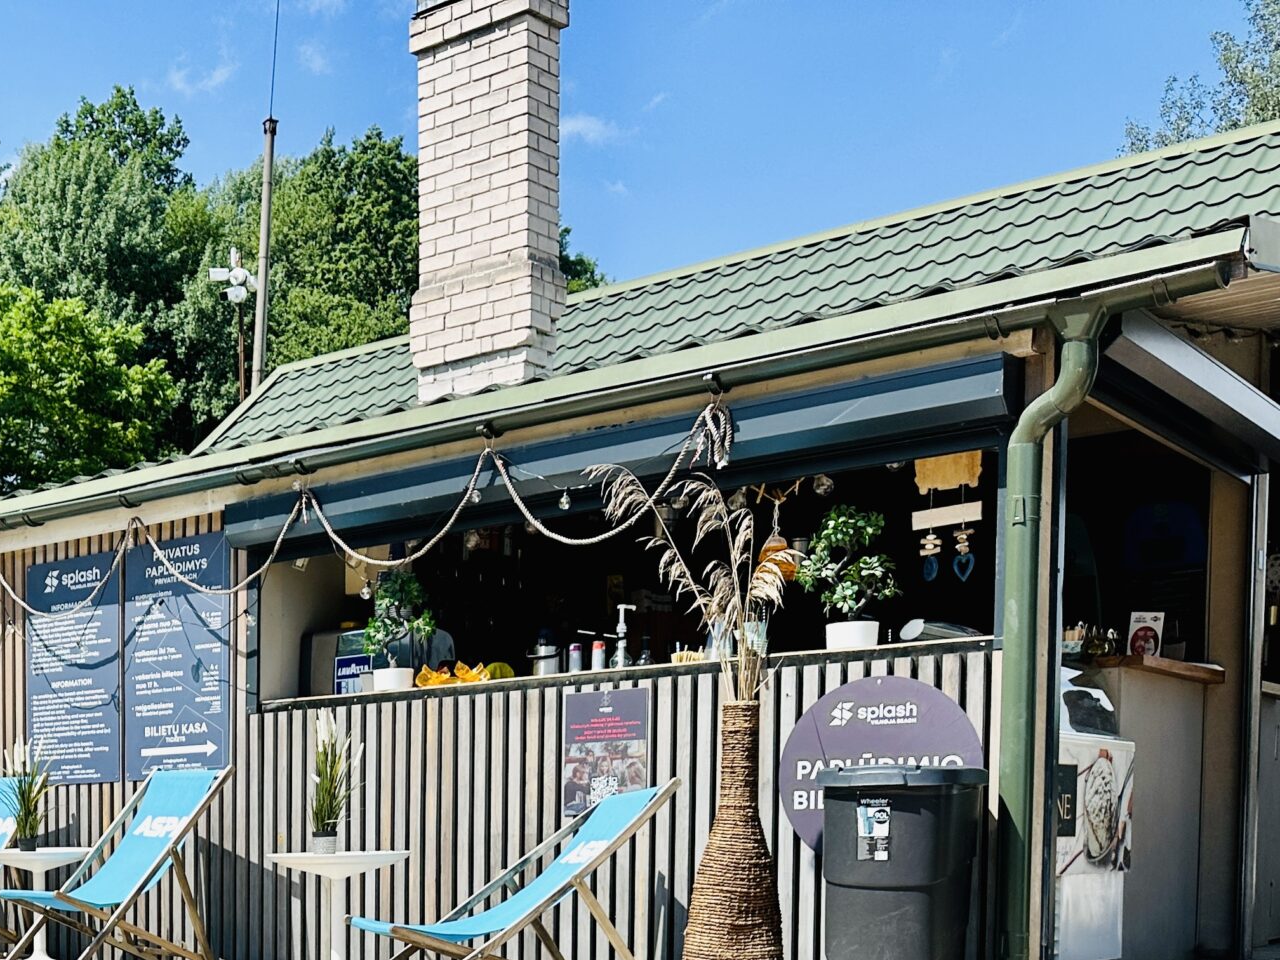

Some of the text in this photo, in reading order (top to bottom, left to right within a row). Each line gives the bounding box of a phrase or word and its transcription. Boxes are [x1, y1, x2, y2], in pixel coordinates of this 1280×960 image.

[153, 544, 200, 561] PRIVATUS
[61, 567, 100, 588] splash
[857, 701, 918, 723] splash
[144, 721, 208, 738] BILIETŲ KASA
[796, 753, 964, 780] PAŪMIO
